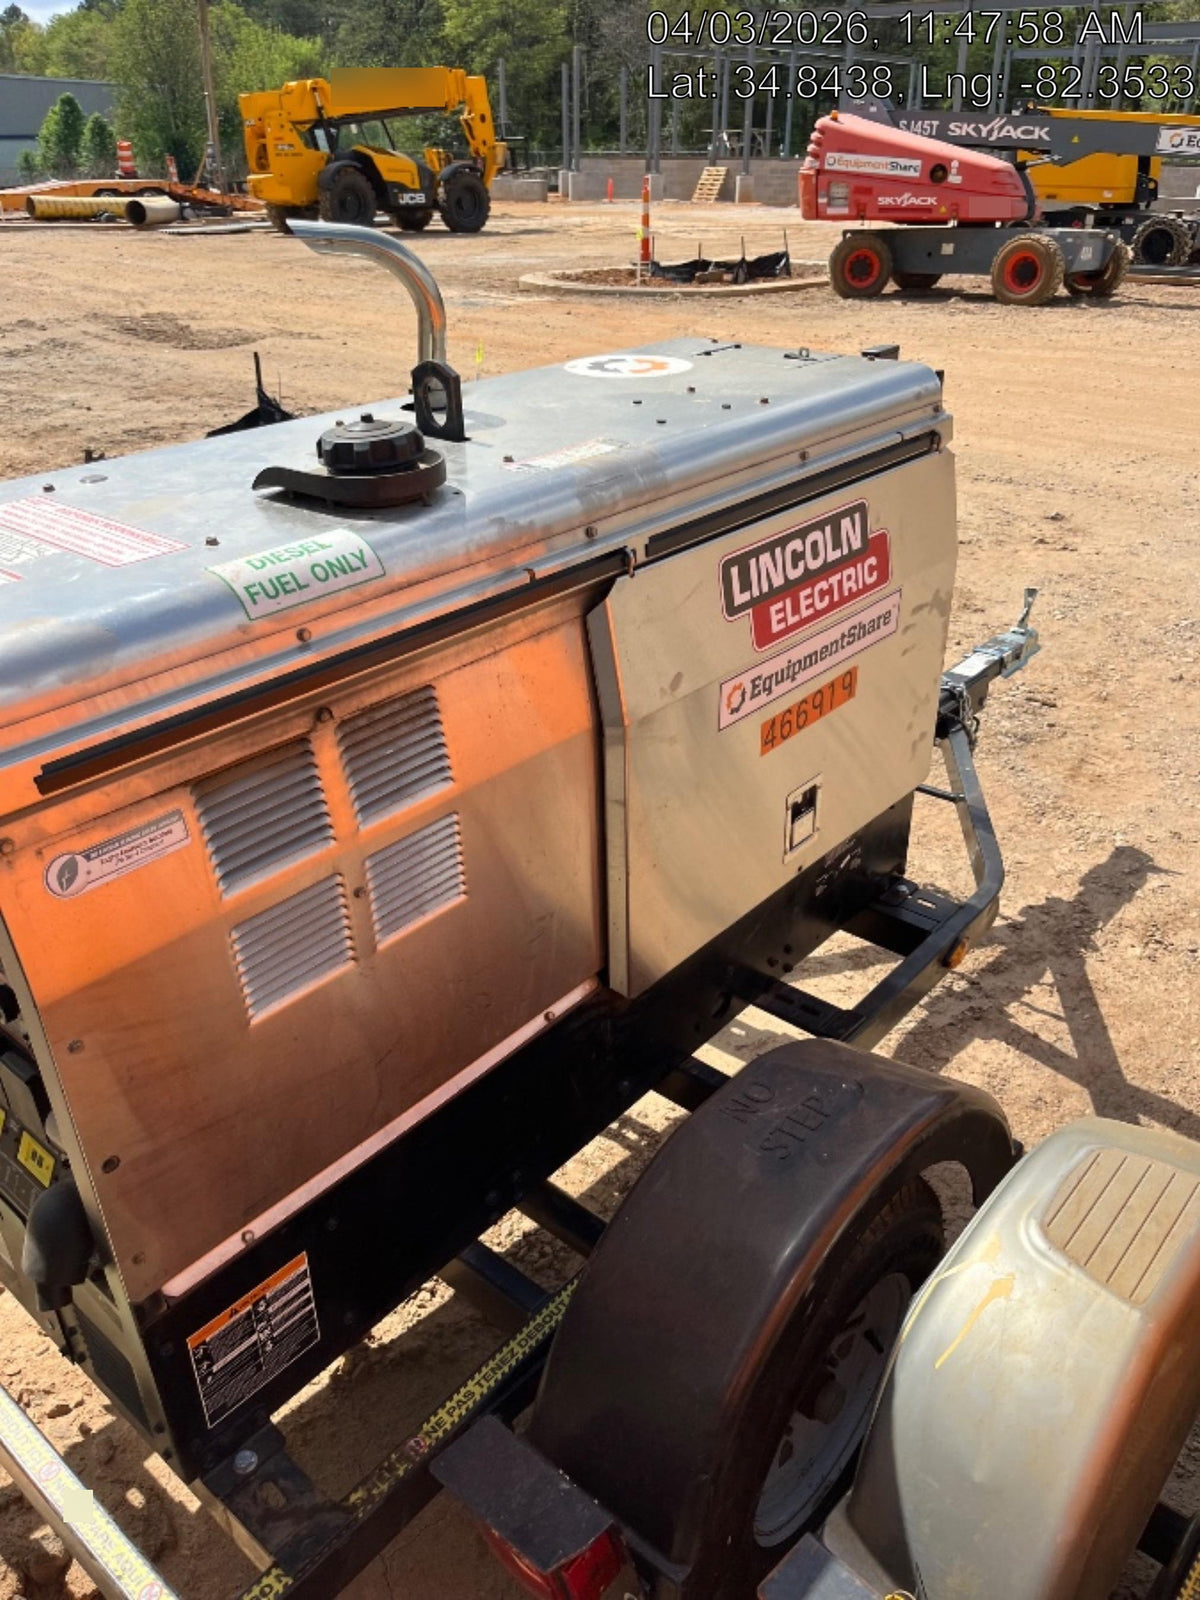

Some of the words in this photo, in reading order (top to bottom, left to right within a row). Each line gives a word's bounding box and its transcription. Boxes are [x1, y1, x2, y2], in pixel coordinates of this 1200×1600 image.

[947, 117, 1052, 141] SKYJACK
[836, 156, 920, 172] EquipmentShare
[398, 193, 426, 204] JCB
[877, 193, 938, 206] SKYJACK
[243, 571, 310, 606] FUEL
[309, 547, 369, 583] ONLY
[245, 540, 334, 570] DIESEL
[730, 511, 863, 607] LINCOLN
[769, 556, 878, 634] ELECTRIC
[750, 608, 892, 701] EquipmentShare
[764, 671, 853, 748] 466919
[720, 1082, 775, 1124] NO
[760, 1096, 832, 1160] STEP
[425, 1417, 446, 1438] NE
[447, 1389, 477, 1418] PAS
[475, 1348, 520, 1389] TENEZ
[516, 1300, 567, 1349] DEBOUT
